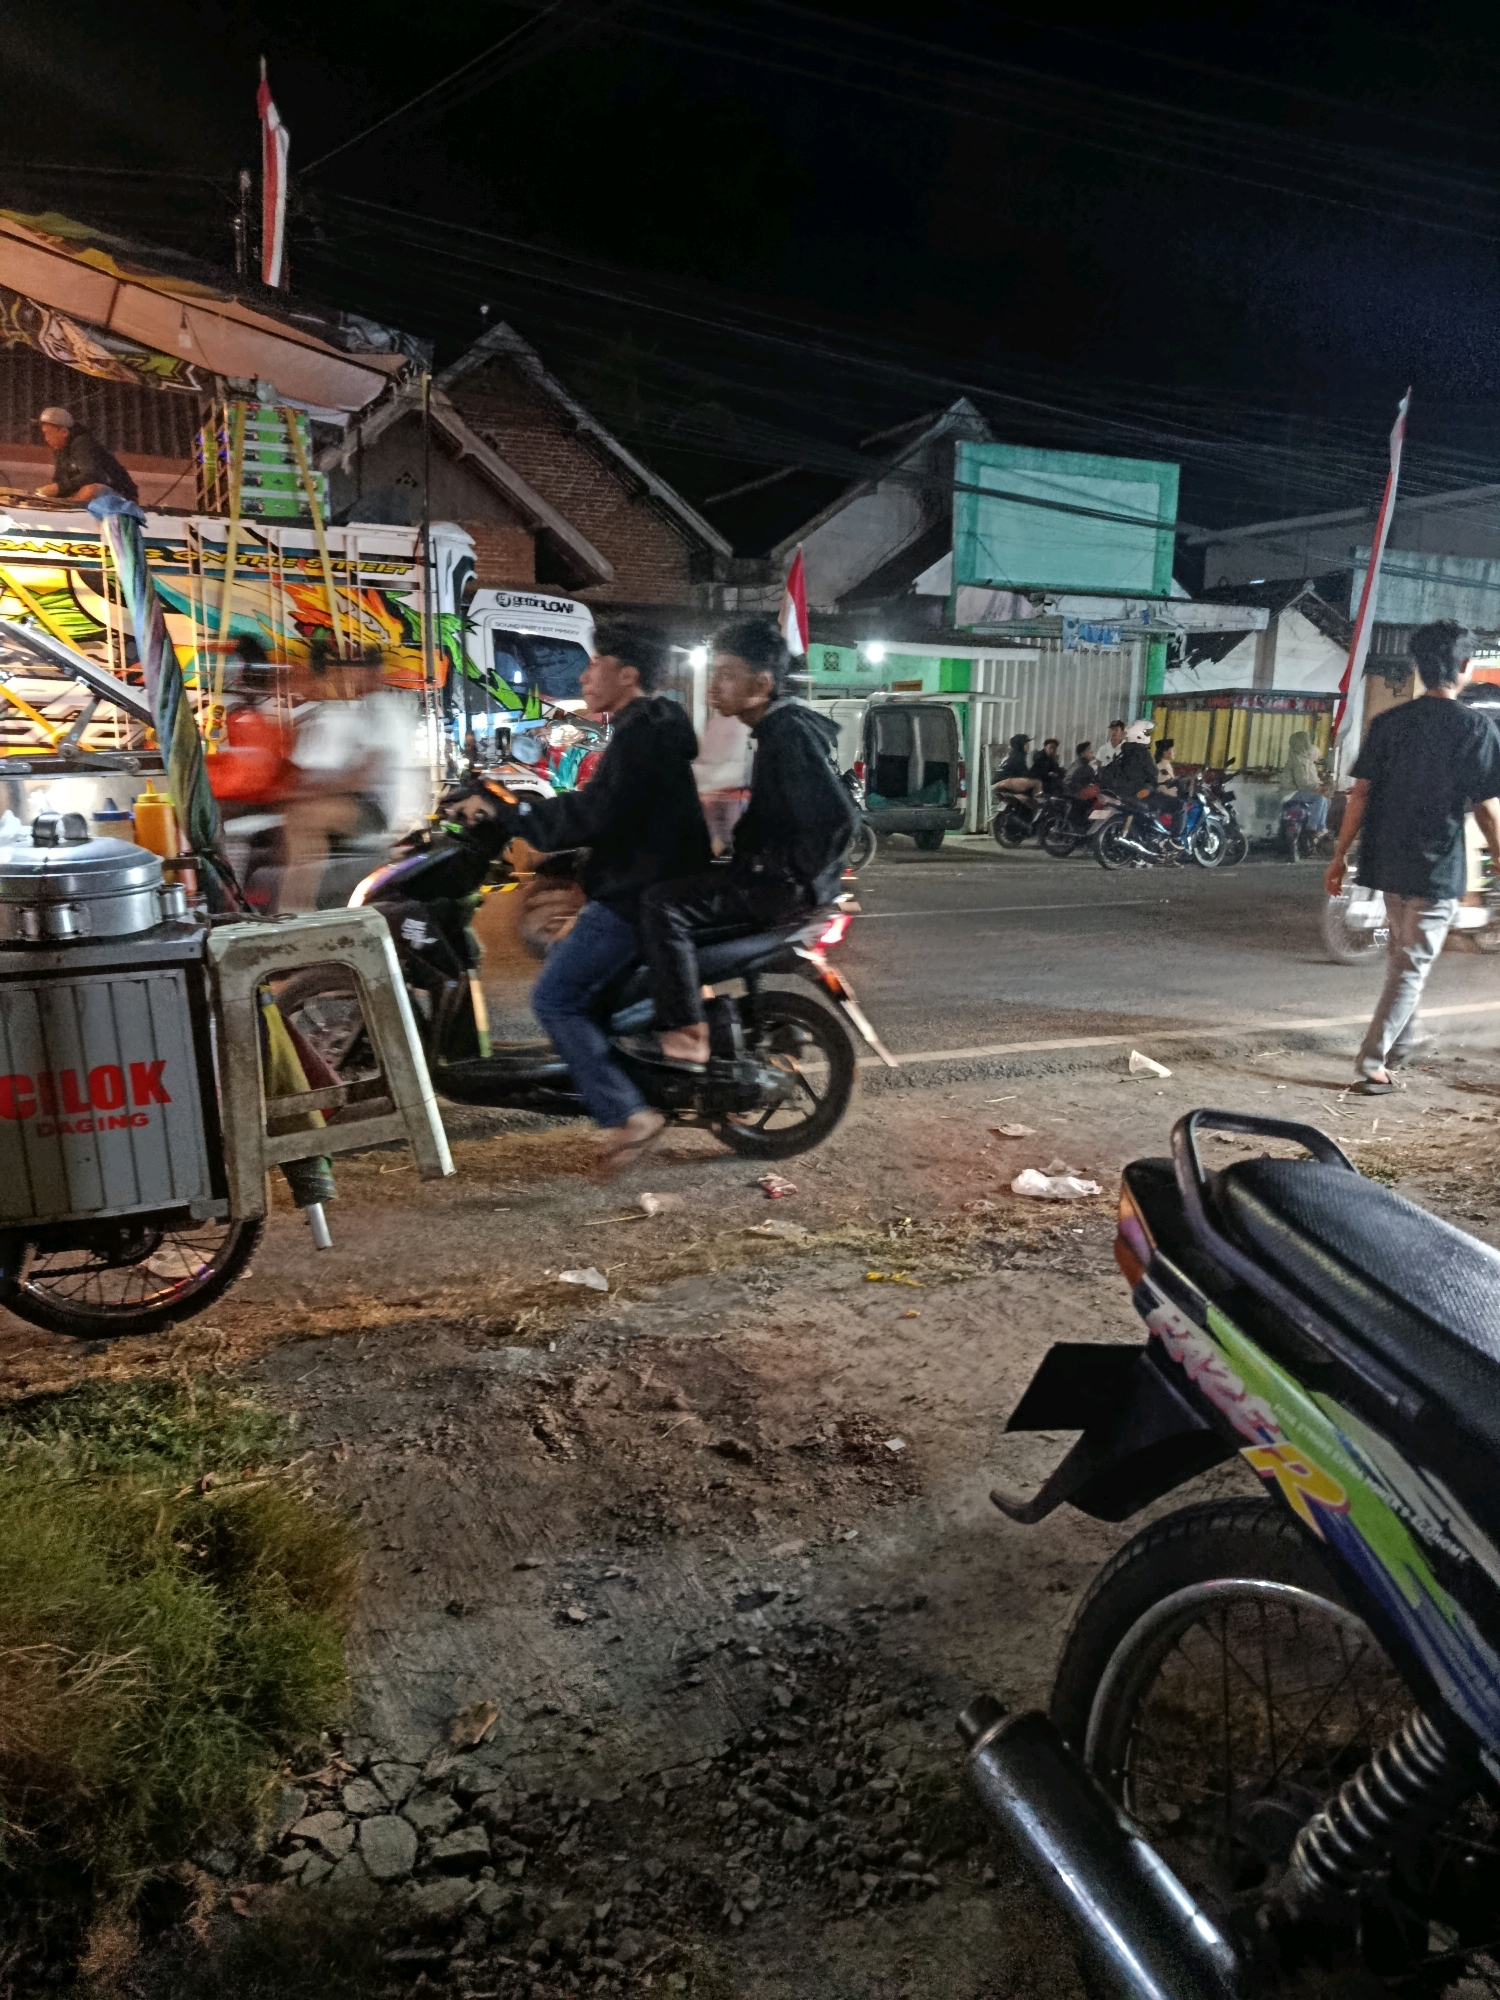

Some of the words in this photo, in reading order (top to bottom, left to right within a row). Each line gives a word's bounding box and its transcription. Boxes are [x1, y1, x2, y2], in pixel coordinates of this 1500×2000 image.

[172, 550, 228, 565] ON
[236, 553, 297, 569] THE
[304, 557, 415, 576] STREET
[494, 621, 520, 629] SOUND
[0, 1060, 172, 1120] CILOK
[36, 1112, 149, 1138] DAGING
[1239, 1442, 1351, 1543] R
